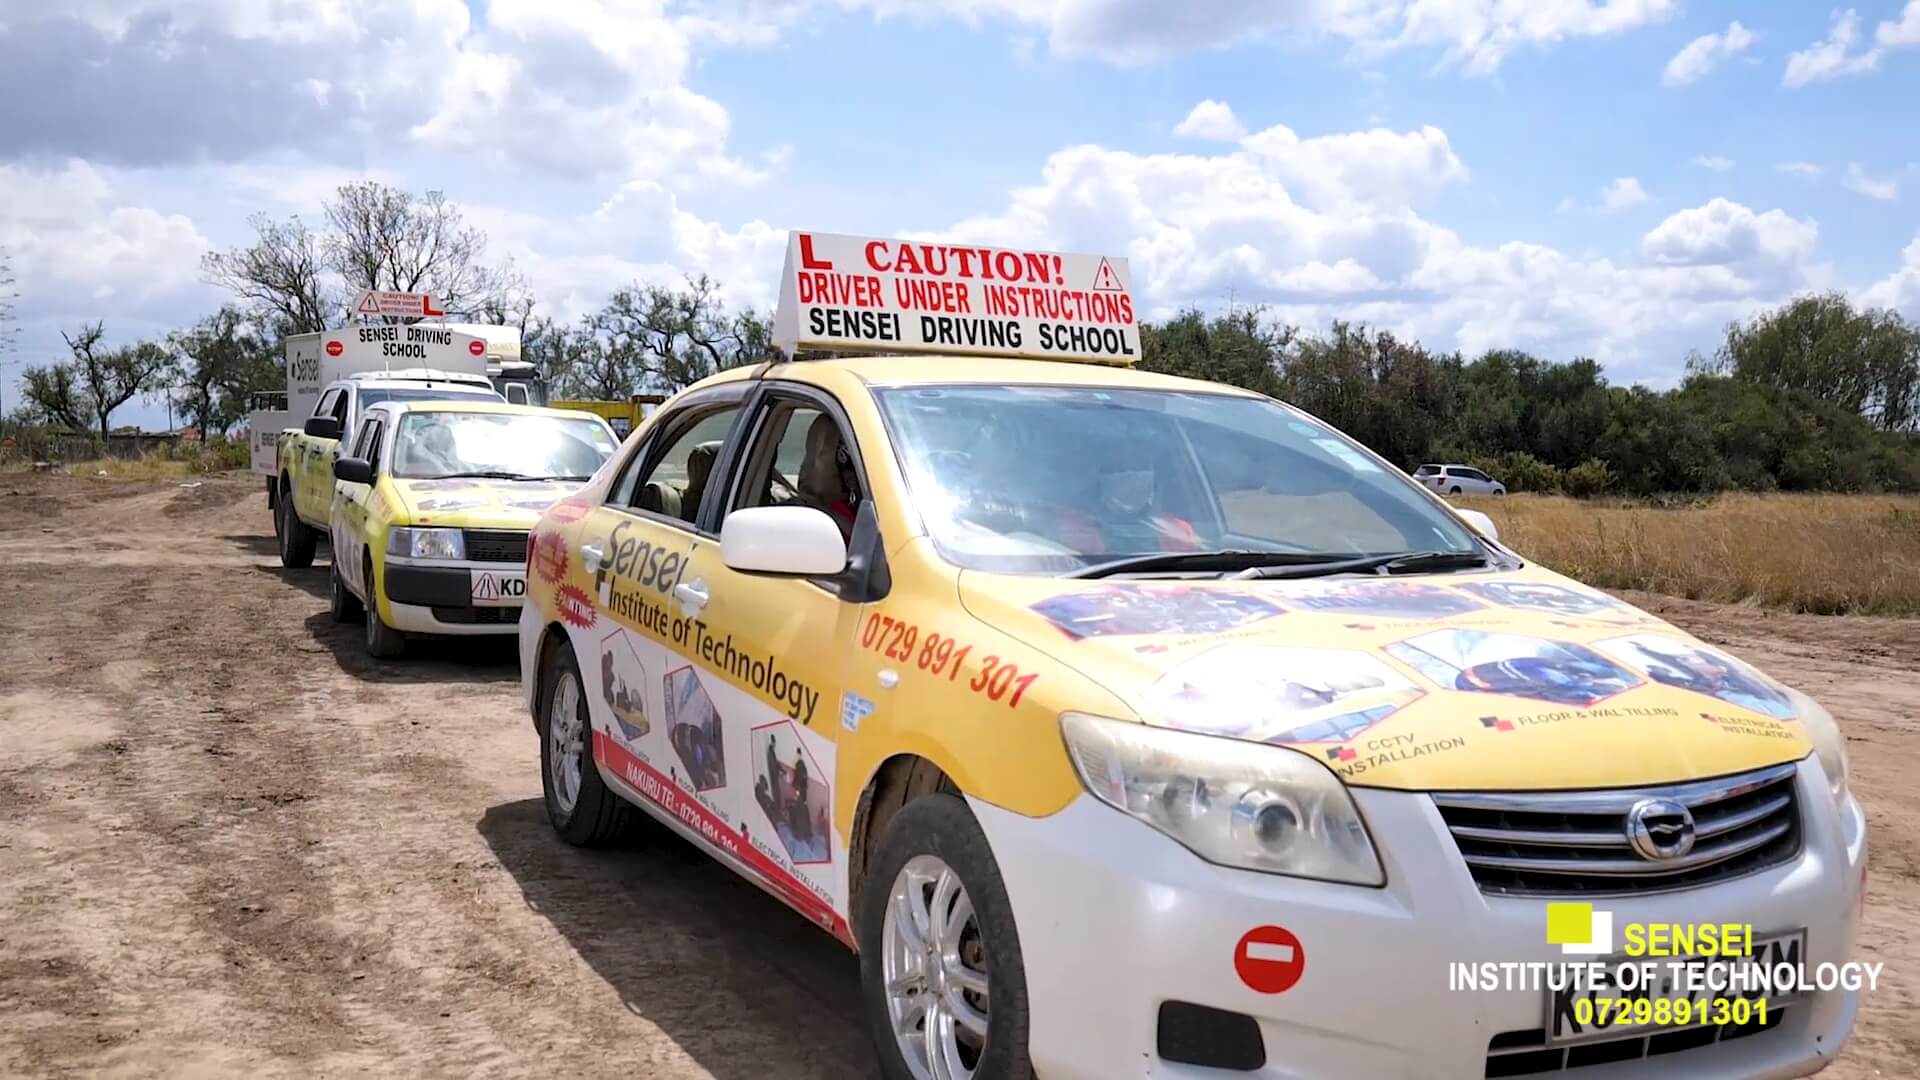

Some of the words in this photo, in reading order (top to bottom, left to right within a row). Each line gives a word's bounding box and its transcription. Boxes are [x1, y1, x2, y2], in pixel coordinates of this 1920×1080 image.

[800, 234, 832, 270] L
[865, 241, 1064, 285] CAUTION!
[423, 295, 444, 316] L
[798, 272, 884, 308] DRIVER
[896, 278, 970, 314] UNDER
[984, 285, 1133, 324] INSTRUCTIONS
[360, 327, 399, 343] SENSEI
[407, 327, 451, 345] DRIVING
[382, 342, 427, 358] SCHOOL
[809, 308, 901, 341] SENSEI
[921, 316, 1022, 348] DRIVING
[1039, 323, 1134, 355] SCHOOL
[600, 520, 698, 598] Sensei
[609, 575, 668, 637] Institute
[672, 615, 694, 648] of
[694, 620, 819, 726] Technology
[862, 612, 918, 663] 0729
[918, 633, 973, 681] 891
[970, 655, 1040, 709] 301
[1517, 710, 1573, 726] FLOOR
[1588, 708, 1623, 719] WAL
[1367, 733, 1415, 751] CCTV
[625, 761, 660, 799] NAKURU
